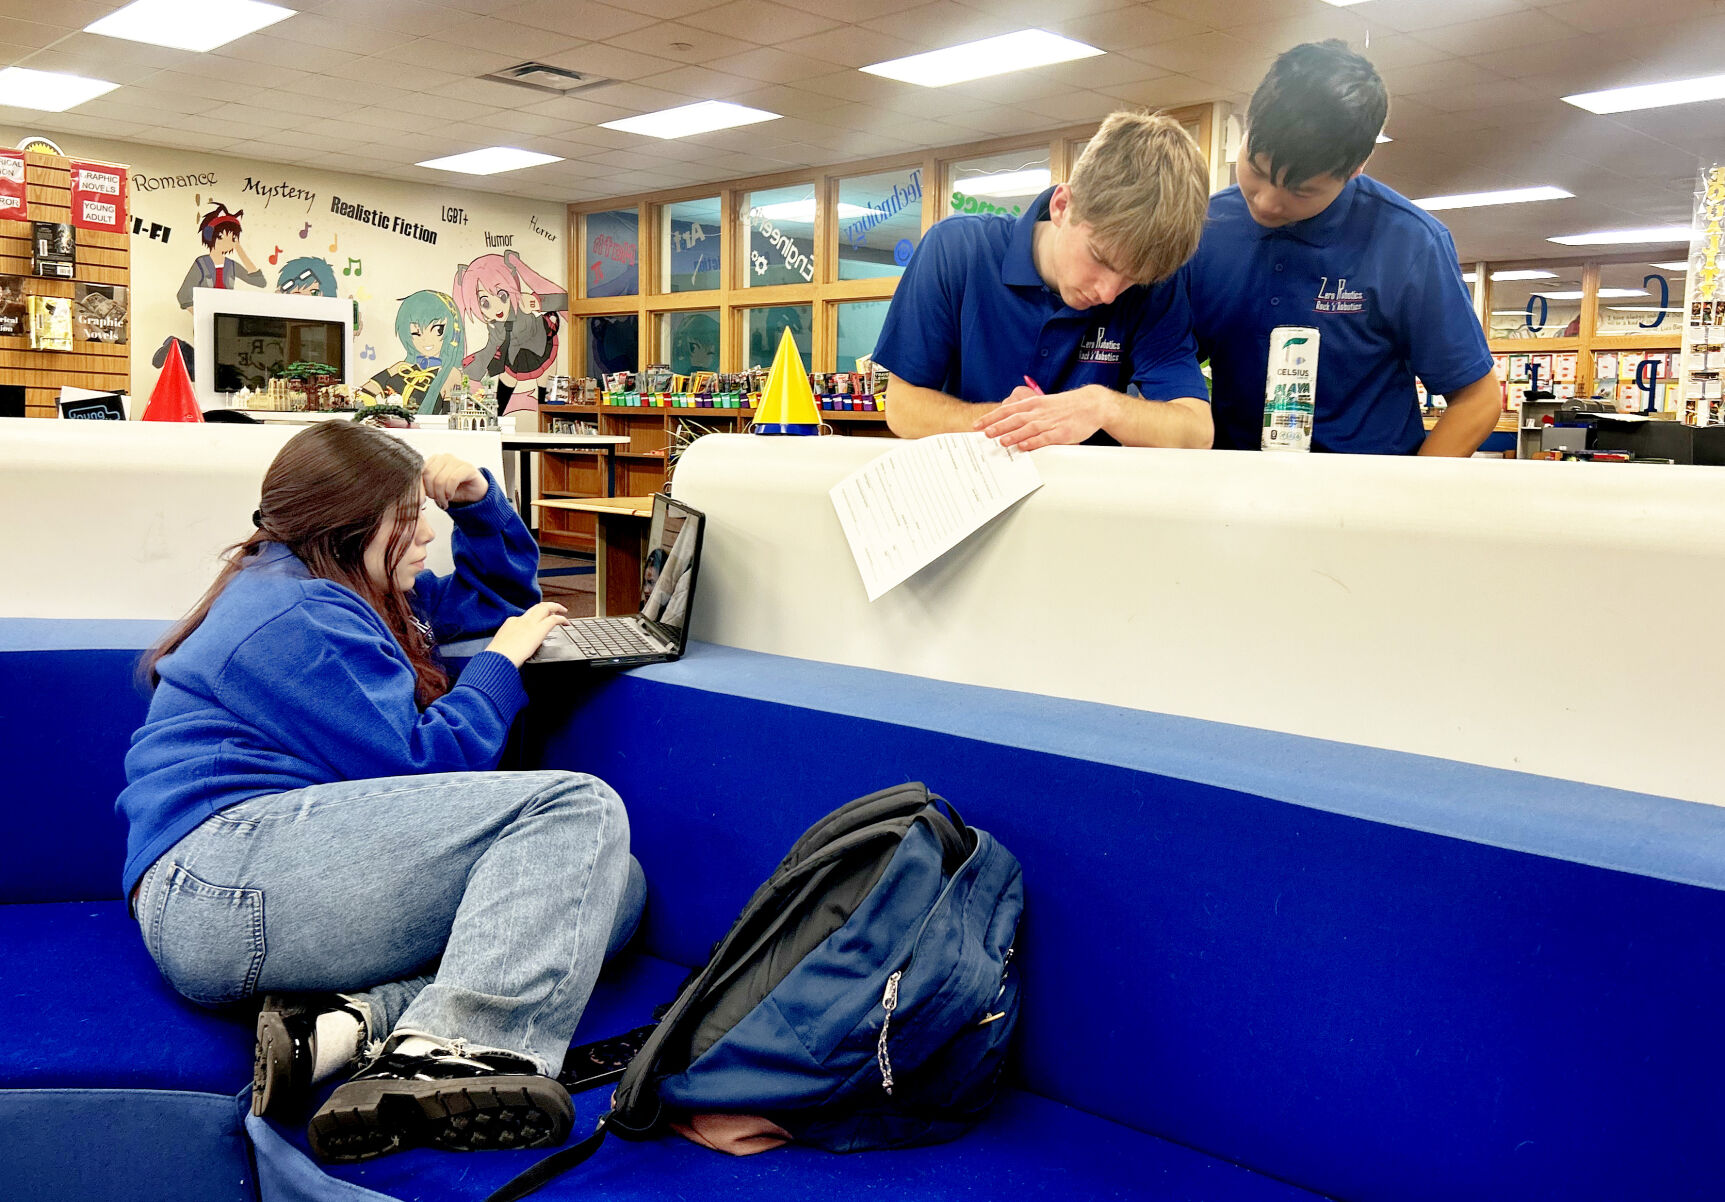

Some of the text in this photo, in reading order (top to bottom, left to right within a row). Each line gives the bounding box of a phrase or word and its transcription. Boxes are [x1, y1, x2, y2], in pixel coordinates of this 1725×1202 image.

[80, 171, 119, 184] RAPHIC
[132, 172, 218, 192] Romance
[82, 182, 117, 194] NOVELS
[242, 177, 316, 214] Mystery
[84, 202, 115, 213] YOUNG
[441, 205, 469, 226] LGBT+
[85, 213, 113, 223] ADULT
[330, 196, 438, 246] Realistic Fiction
[129, 214, 172, 244] I-FI
[528, 215, 559, 242] Horror
[484, 231, 515, 248] Humor
[1317, 276, 1363, 300] Zero Robotics
[78, 314, 124, 328] Graphic
[83, 328, 119, 341] Novels
[1095, 327, 1121, 350] Robotics
[1277, 368, 1309, 377] CELSIUS
